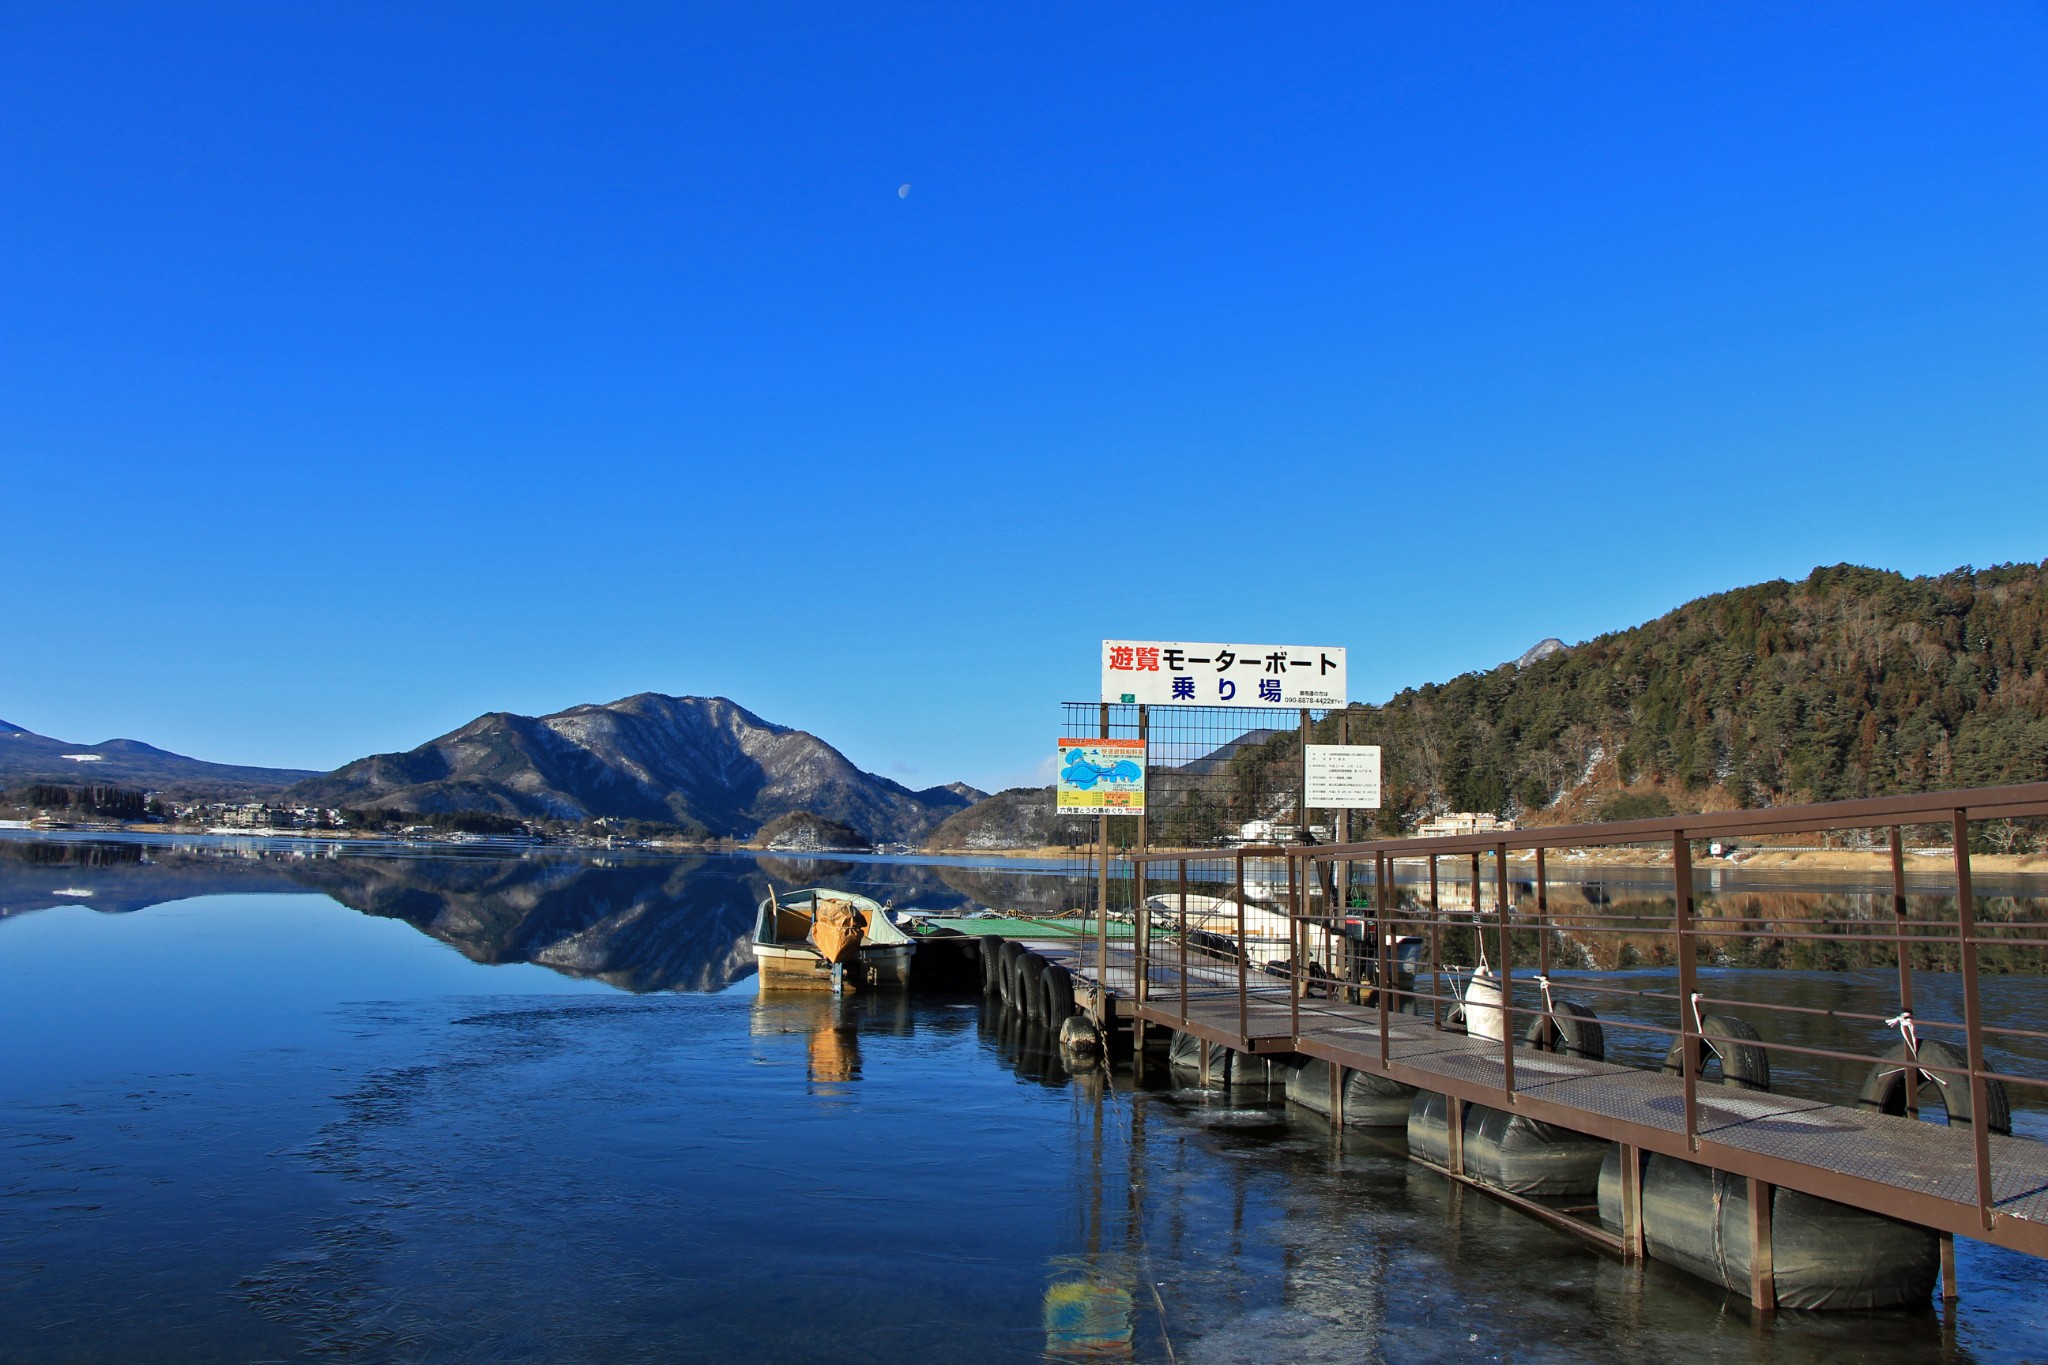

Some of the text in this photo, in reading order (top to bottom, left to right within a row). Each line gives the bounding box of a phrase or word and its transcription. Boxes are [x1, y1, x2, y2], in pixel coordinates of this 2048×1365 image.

[1109, 646, 1337, 676] 遊覧モーターボート
[1171, 676, 1282, 703] 乗り場
